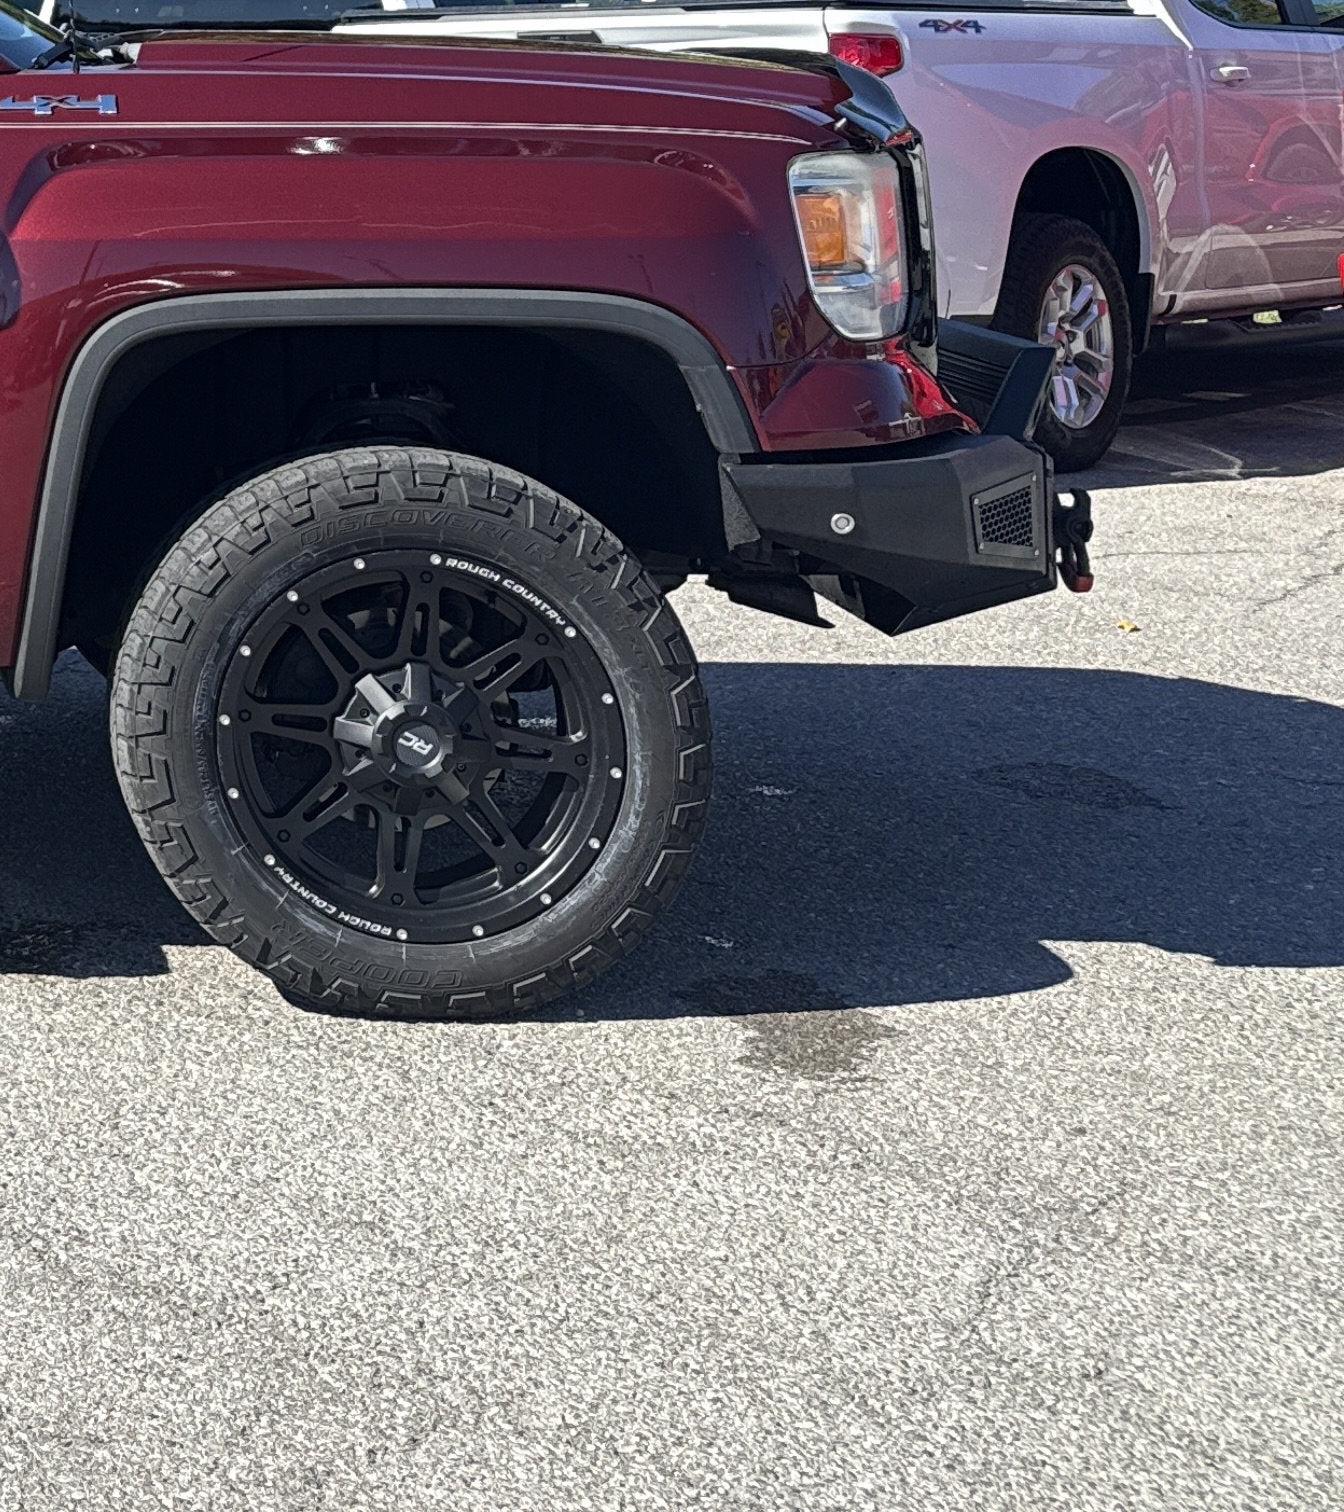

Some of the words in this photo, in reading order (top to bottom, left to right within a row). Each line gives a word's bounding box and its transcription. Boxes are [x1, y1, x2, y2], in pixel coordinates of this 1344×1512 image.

[445, 557, 502, 582] ROUGH
[502, 578, 567, 627] COUNTRY
[273, 866, 337, 915] COUNTRY
[338, 910, 393, 937] ROUGH
